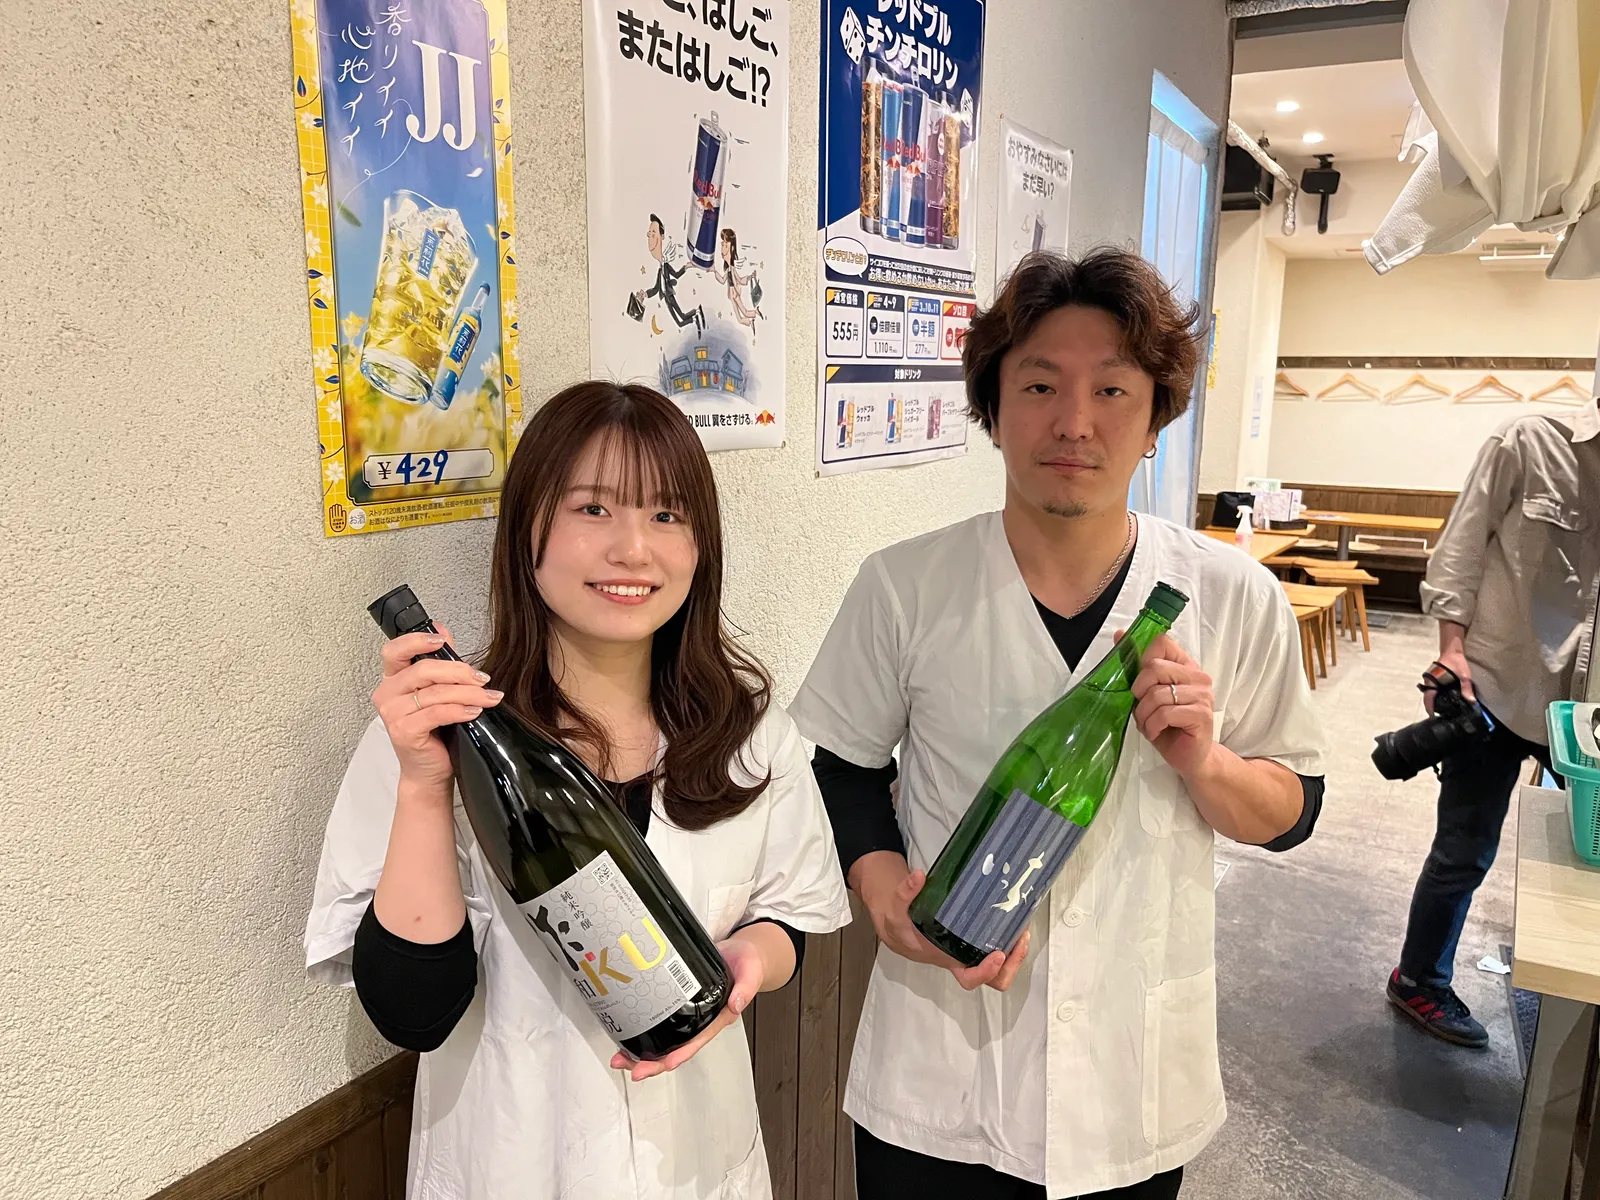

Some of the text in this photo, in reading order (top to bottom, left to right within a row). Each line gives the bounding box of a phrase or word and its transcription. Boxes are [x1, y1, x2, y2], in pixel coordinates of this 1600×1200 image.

[662, 0, 779, 57] 、はしご、
[866, 15, 958, 89] チンチロリン
[338, 23, 376, 157] 心地イイ
[375, 2, 412, 139] 香りイイ
[406, 40, 482, 151] JJ
[1007, 136, 1068, 182] おやすみなさいには
[695, 414, 711, 427] BULL
[396, 449, 449, 486] 429
[560, 890, 594, 932] 純米吟醸
